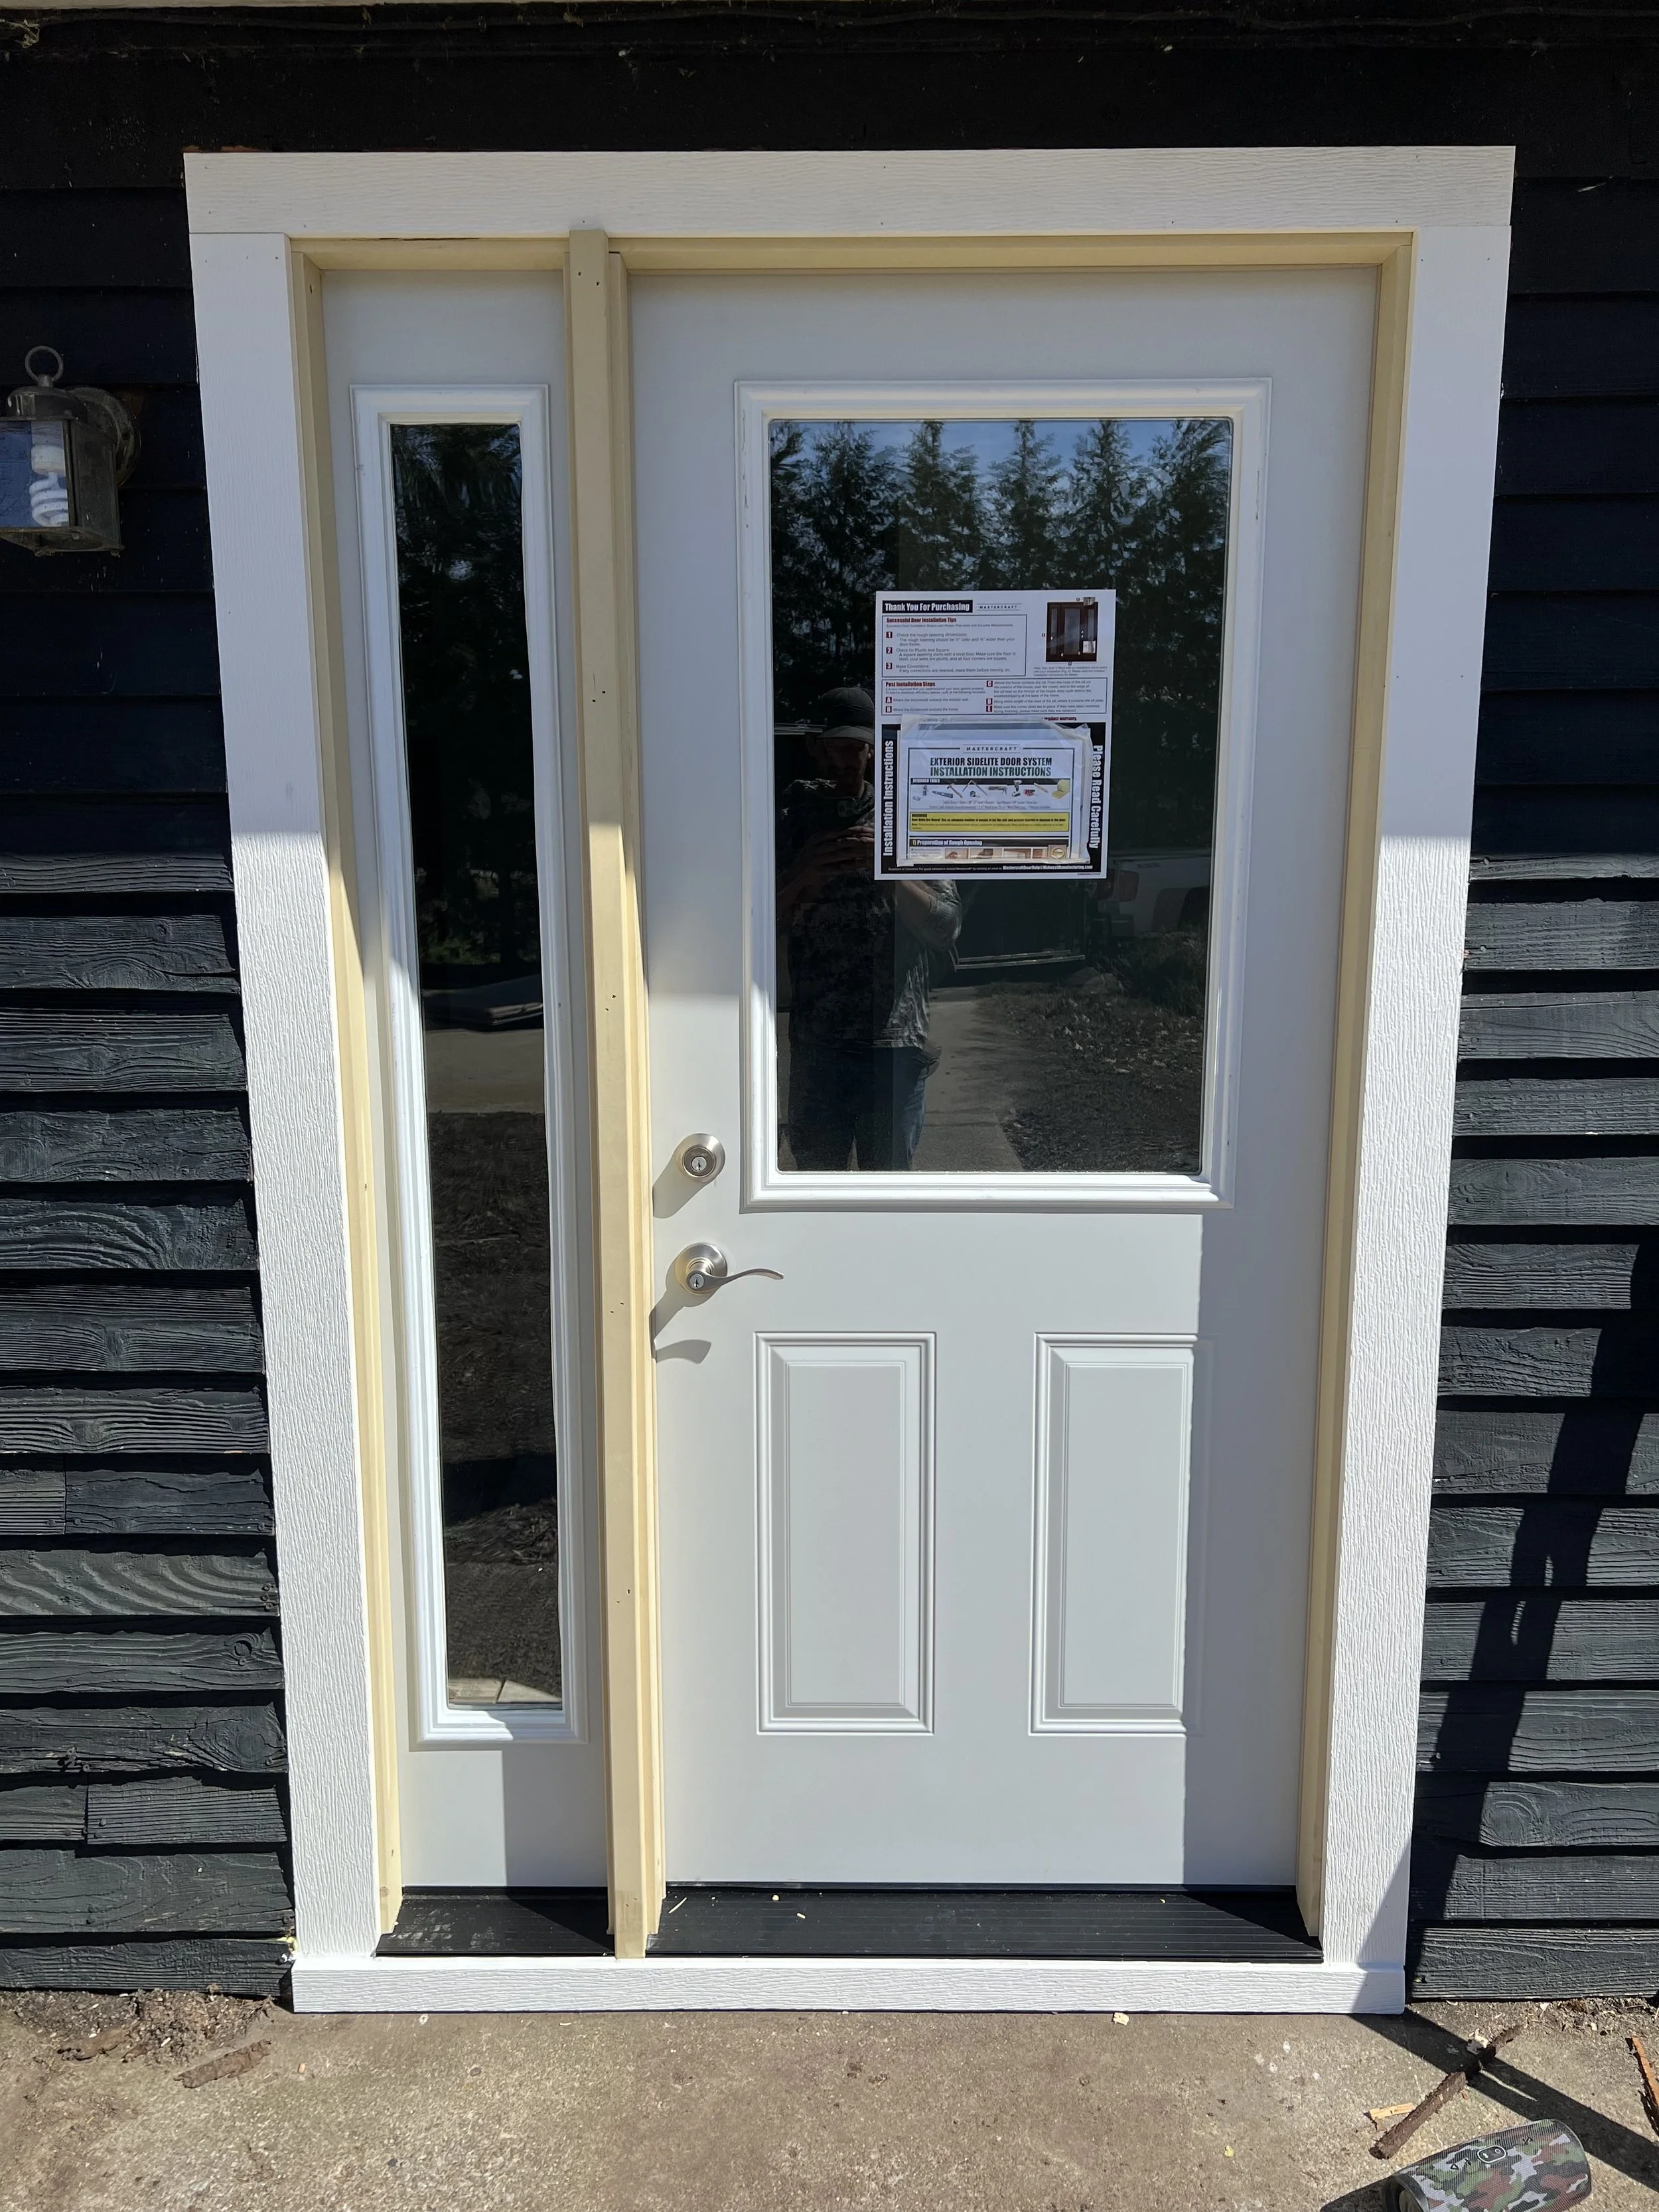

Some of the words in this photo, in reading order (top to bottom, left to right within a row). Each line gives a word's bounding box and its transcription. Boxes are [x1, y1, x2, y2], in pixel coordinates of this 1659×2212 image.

[885, 603, 906, 611] Thank
[906, 603, 918, 611] You
[920, 603, 930, 611] For
[931, 603, 970, 611] Purchasing
[883, 740, 894, 800] Instructions
[930, 757, 965, 766] EXTERIOR
[967, 757, 999, 766] SIDELITE
[1000, 757, 1021, 766] DOOR
[1023, 757, 1052, 766] SYSTEM
[930, 767, 987, 776] INSTALLATION
[989, 767, 1052, 776] INSTRUCTIONS
[1092, 745, 1103, 777] Please
[1091, 779, 1102, 804] Read
[883, 800, 893, 856] Installation
[1089, 805, 1102, 849] Carefully
